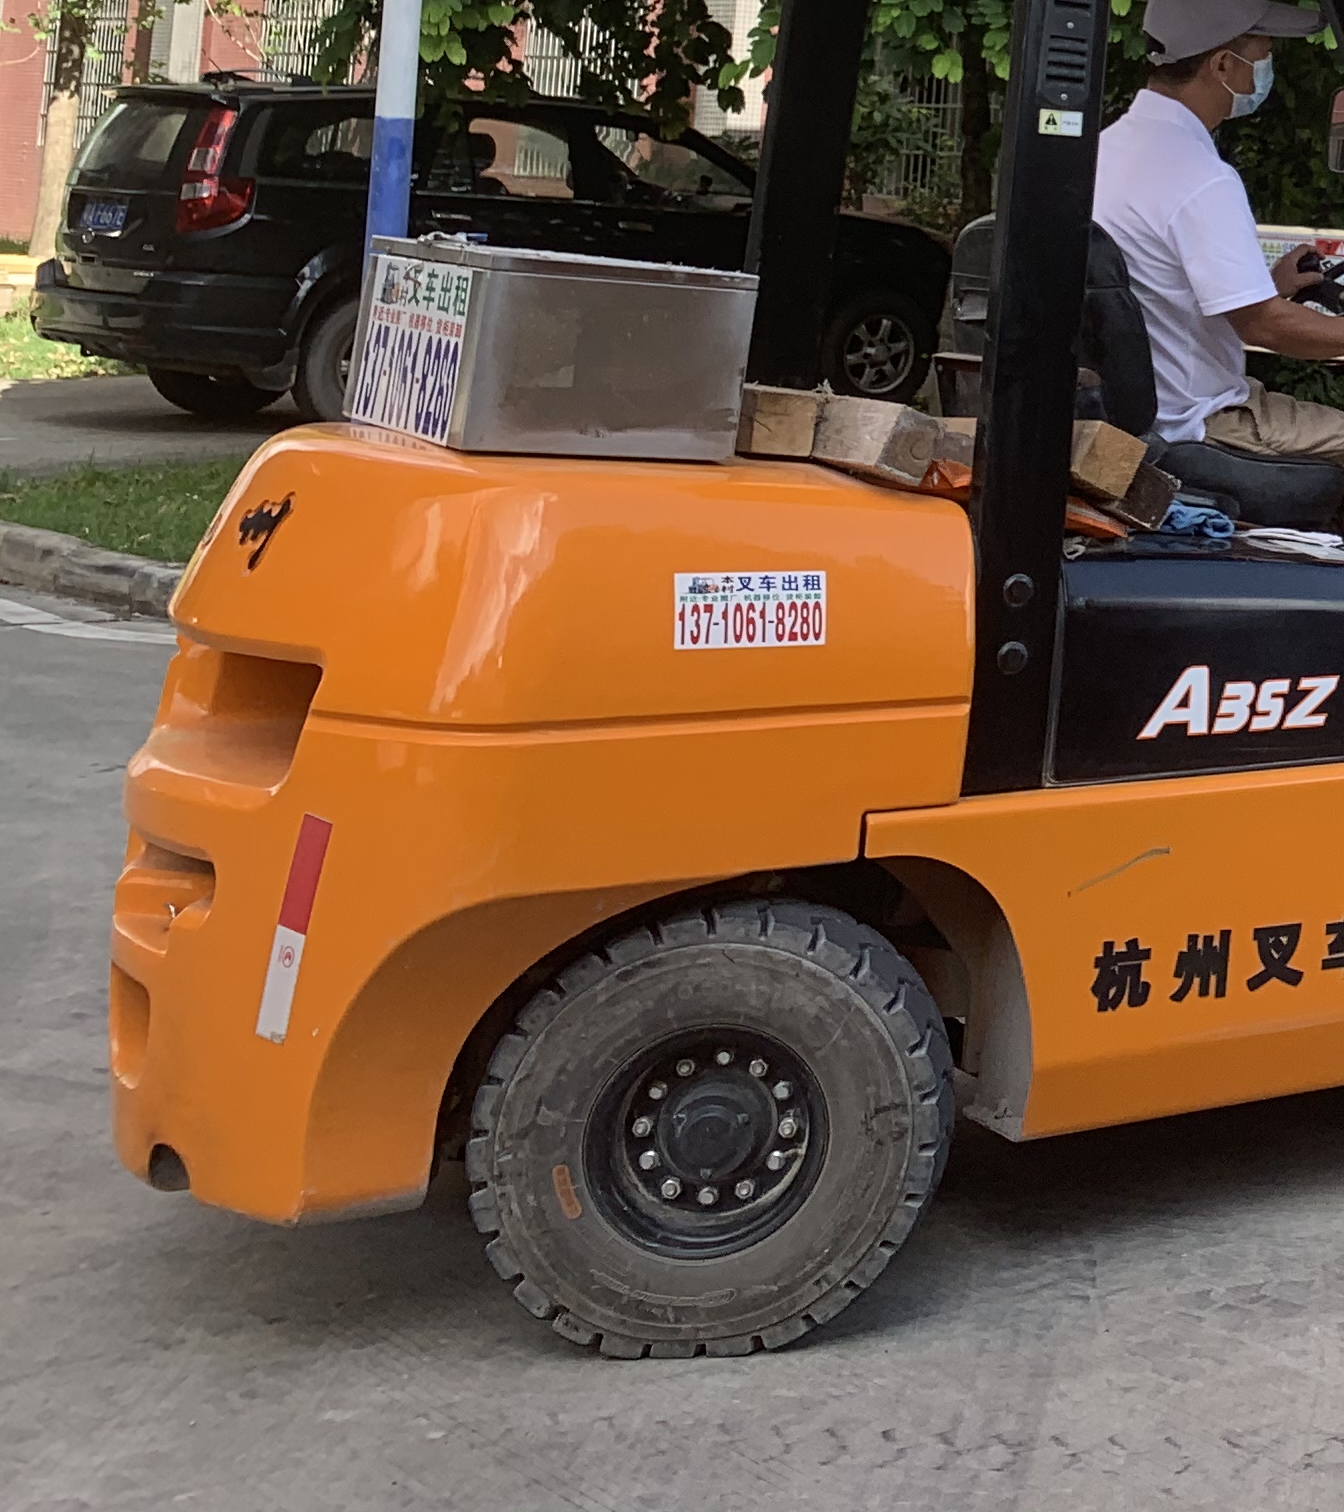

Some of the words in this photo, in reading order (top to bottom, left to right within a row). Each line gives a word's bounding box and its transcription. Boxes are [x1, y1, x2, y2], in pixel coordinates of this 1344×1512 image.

[407, 267, 469, 316] 叉车出租
[355, 321, 460, 442] 137-1061-8280
[736, 575, 822, 592] 叉车出租
[679, 601, 822, 645] 137-1061-8280
